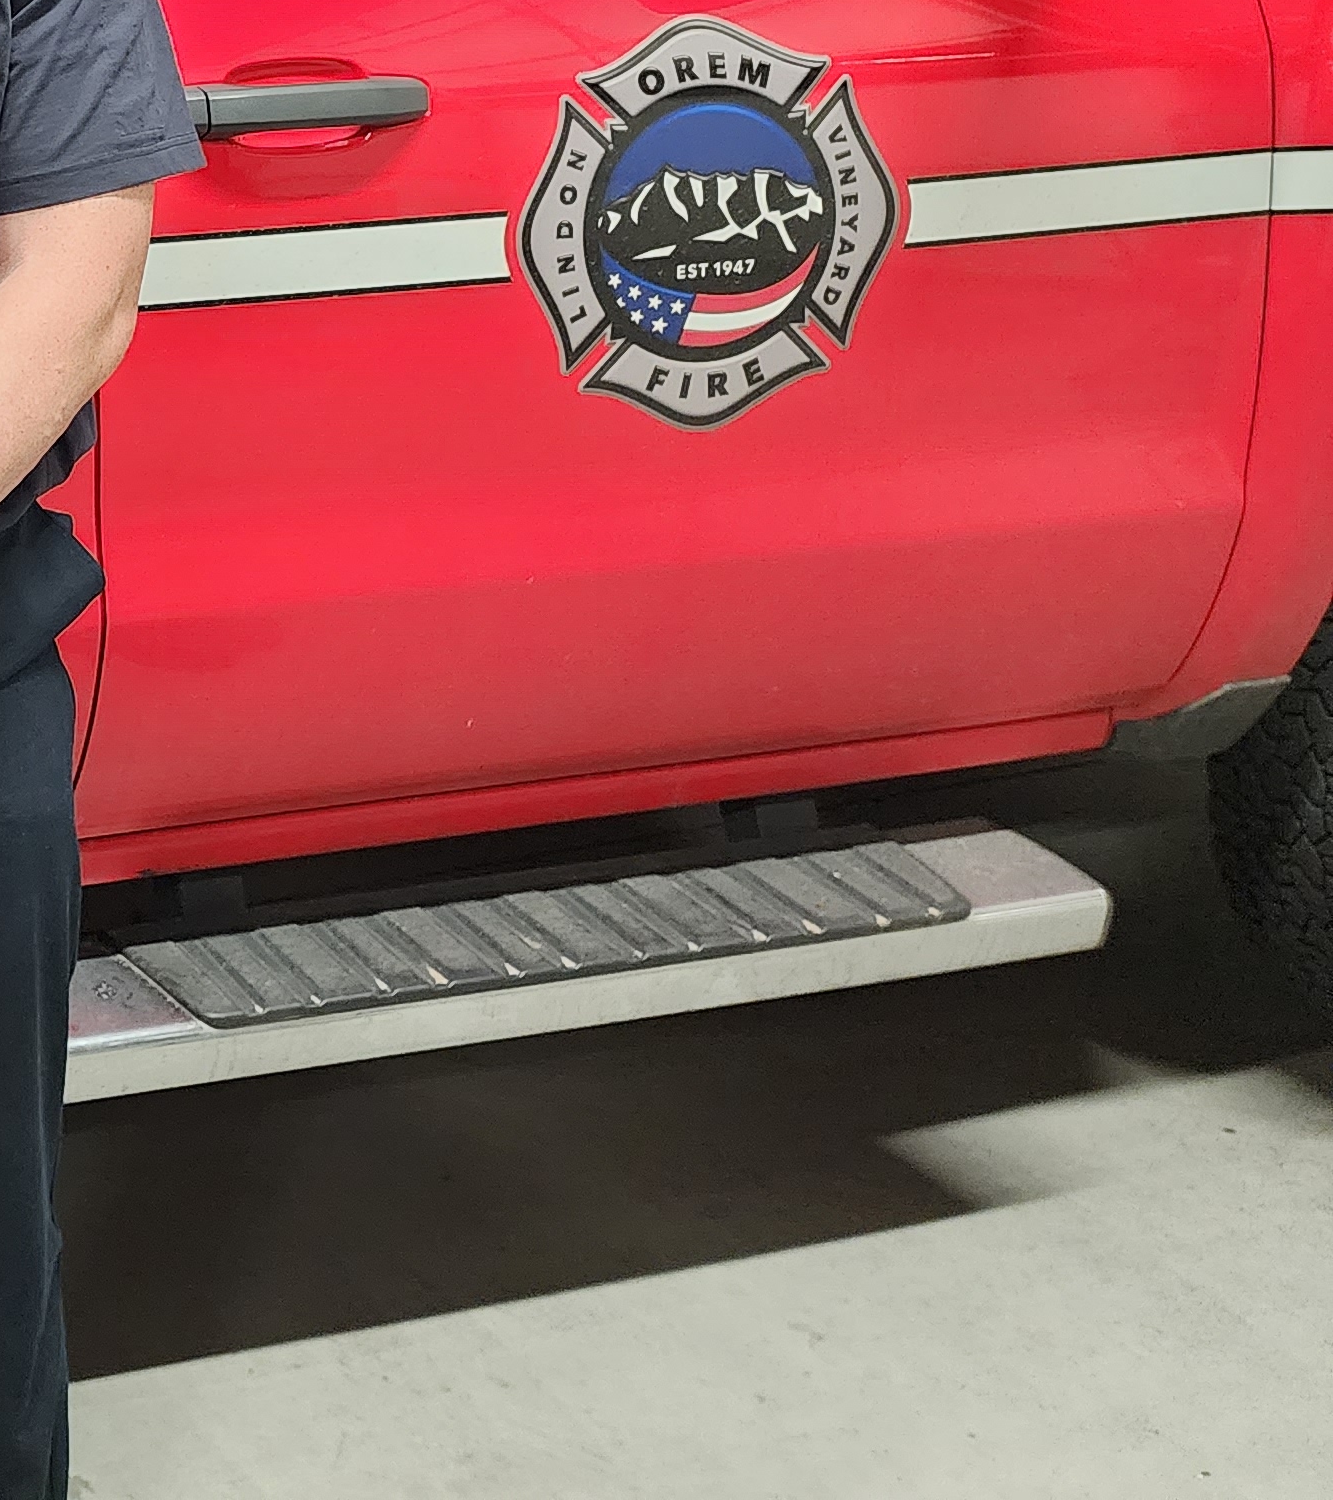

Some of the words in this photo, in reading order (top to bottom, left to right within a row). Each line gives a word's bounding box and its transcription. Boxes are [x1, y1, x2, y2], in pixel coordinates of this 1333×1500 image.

[637, 51, 773, 97] OREM
[555, 149, 589, 326] LINDON
[827, 124, 860, 308] VINEYARD
[676, 261, 710, 281] EST
[712, 258, 756, 278] 1947
[644, 356, 766, 400] FIRE
